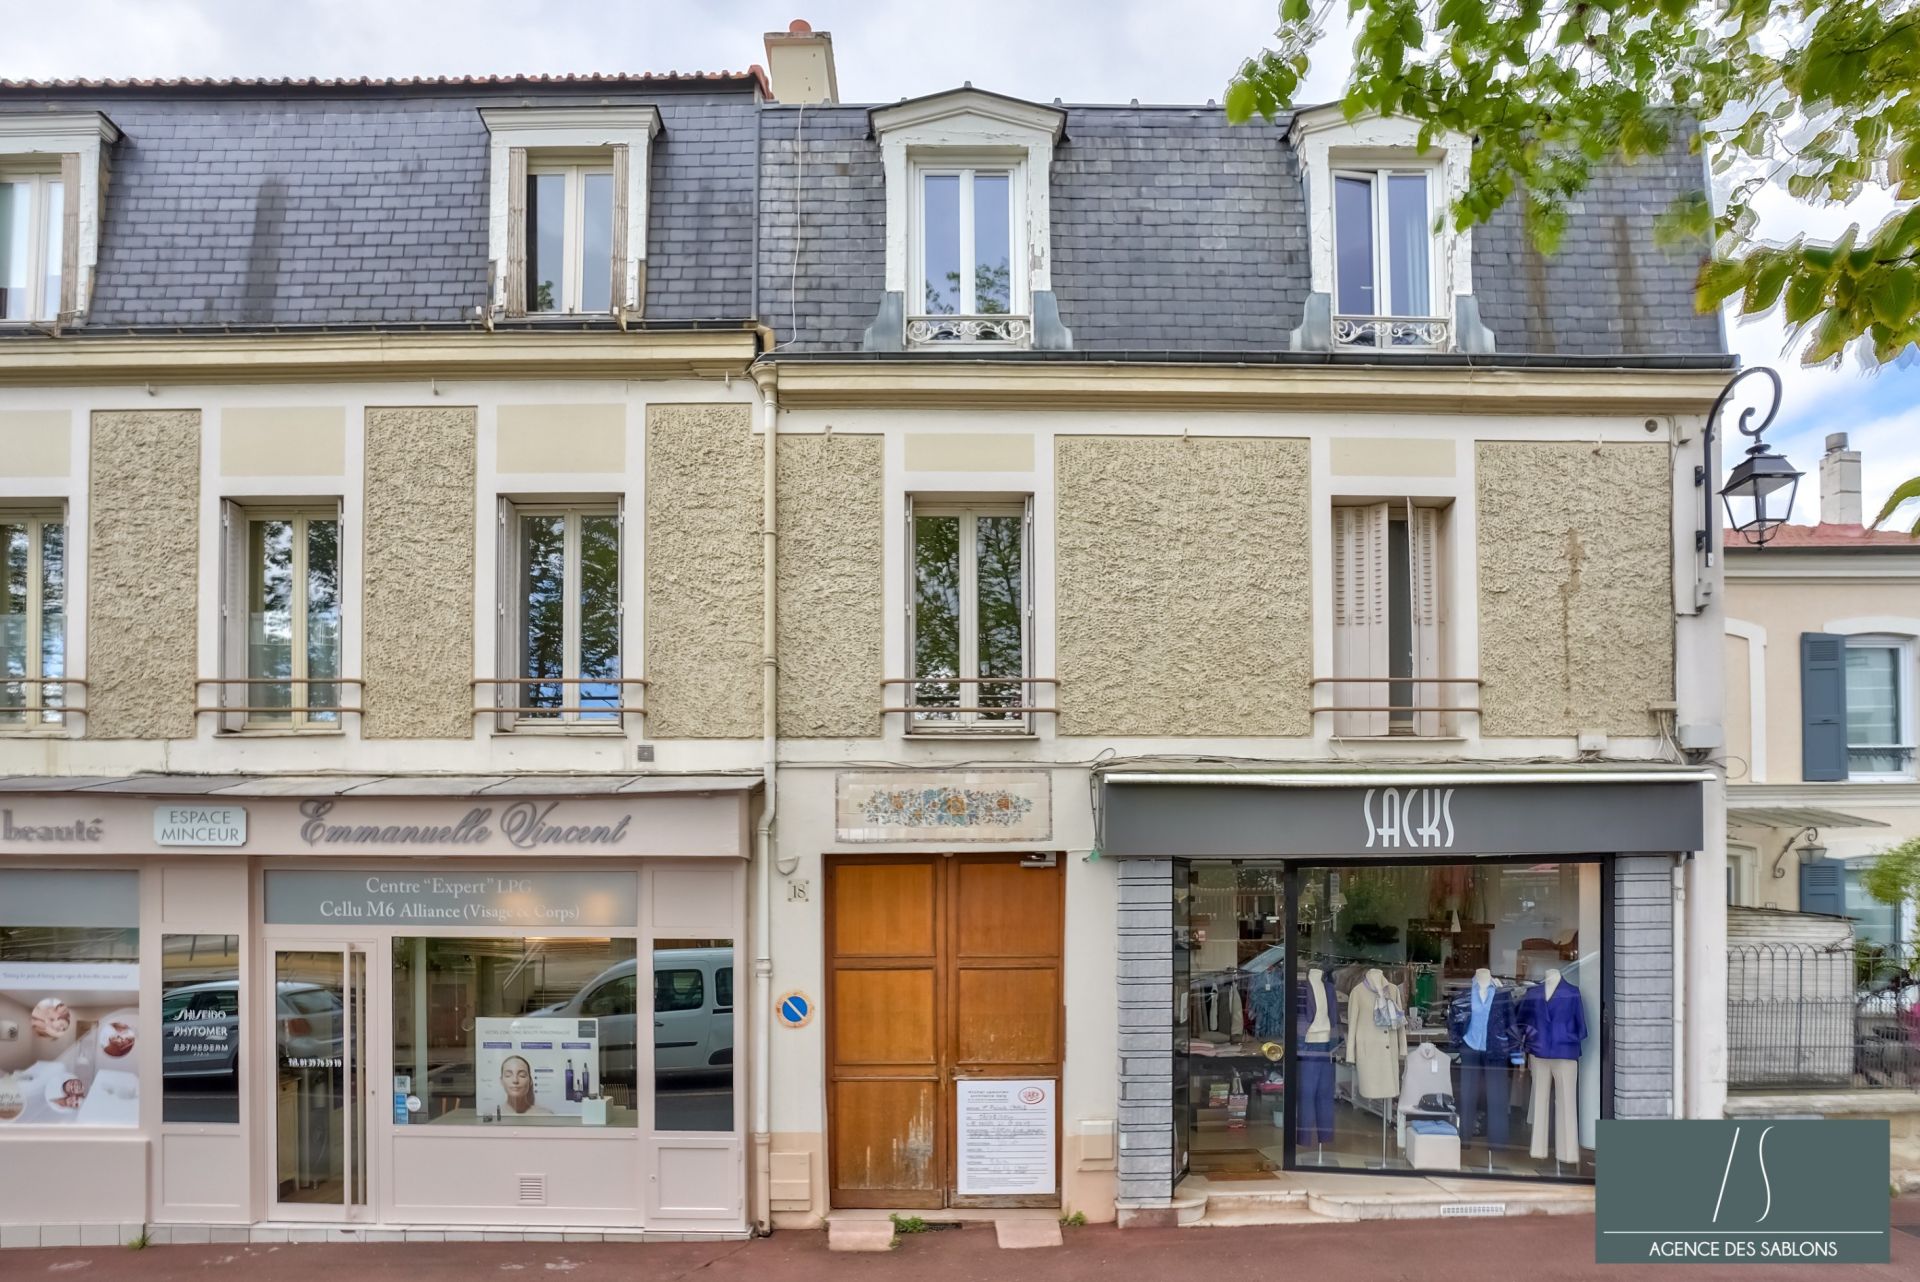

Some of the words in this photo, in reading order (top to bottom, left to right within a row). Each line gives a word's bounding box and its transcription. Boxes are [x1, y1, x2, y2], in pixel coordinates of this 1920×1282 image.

[2, 808, 104, 842] beauté
[169, 810, 232, 825] ESPACE
[299, 799, 493, 847] Emmanuelle
[499, 801, 632, 849] Vincent
[1363, 787, 1455, 848] SACKS
[160, 827, 240, 842] MINCEUR
[365, 877, 421, 894] Centre
[497, 878, 533, 894] LPG
[791, 884, 806, 899] 18
[319, 900, 363, 918] Cellu
[366, 900, 396, 918] M6
[400, 902, 461, 918] Alliance
[463, 904, 513, 923] (Visage
[534, 904, 580, 922] Corps)
[172, 1008, 227, 1021] SHISEIDO
[173, 1025, 228, 1037] PHYTOMER
